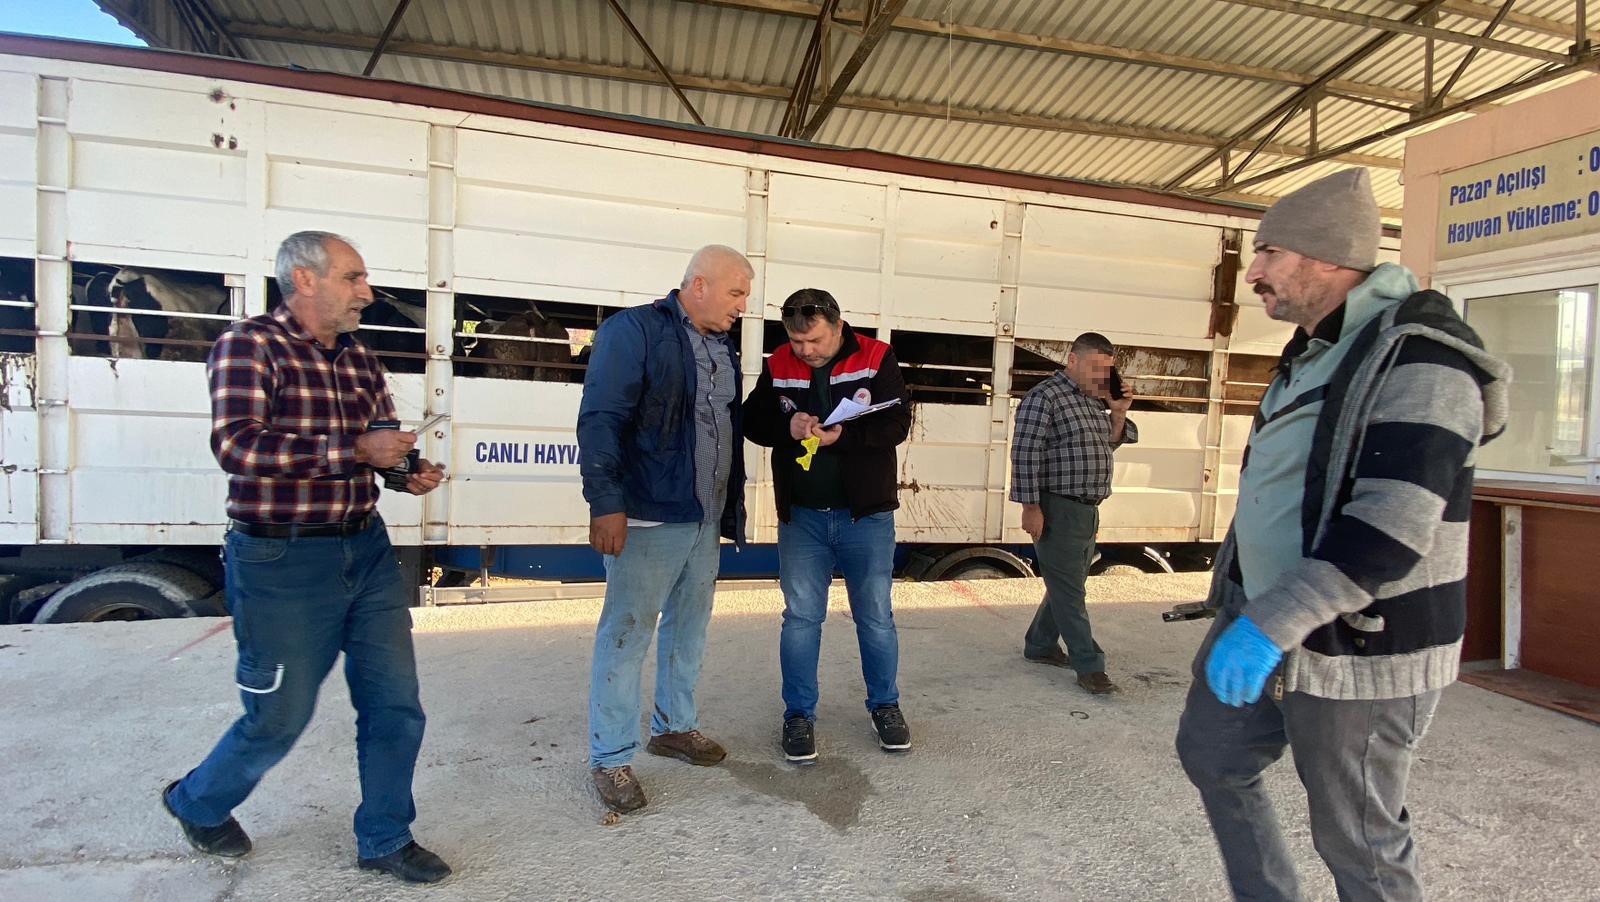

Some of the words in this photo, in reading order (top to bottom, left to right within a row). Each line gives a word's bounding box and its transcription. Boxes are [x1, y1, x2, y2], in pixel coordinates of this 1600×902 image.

[1450, 178, 1492, 206] Pazar
[1496, 165, 1546, 197] Açılışı
[1447, 216, 1502, 244] Hayvan
[1506, 199, 1582, 232] Yükleme:
[475, 441, 528, 463] CANLI
